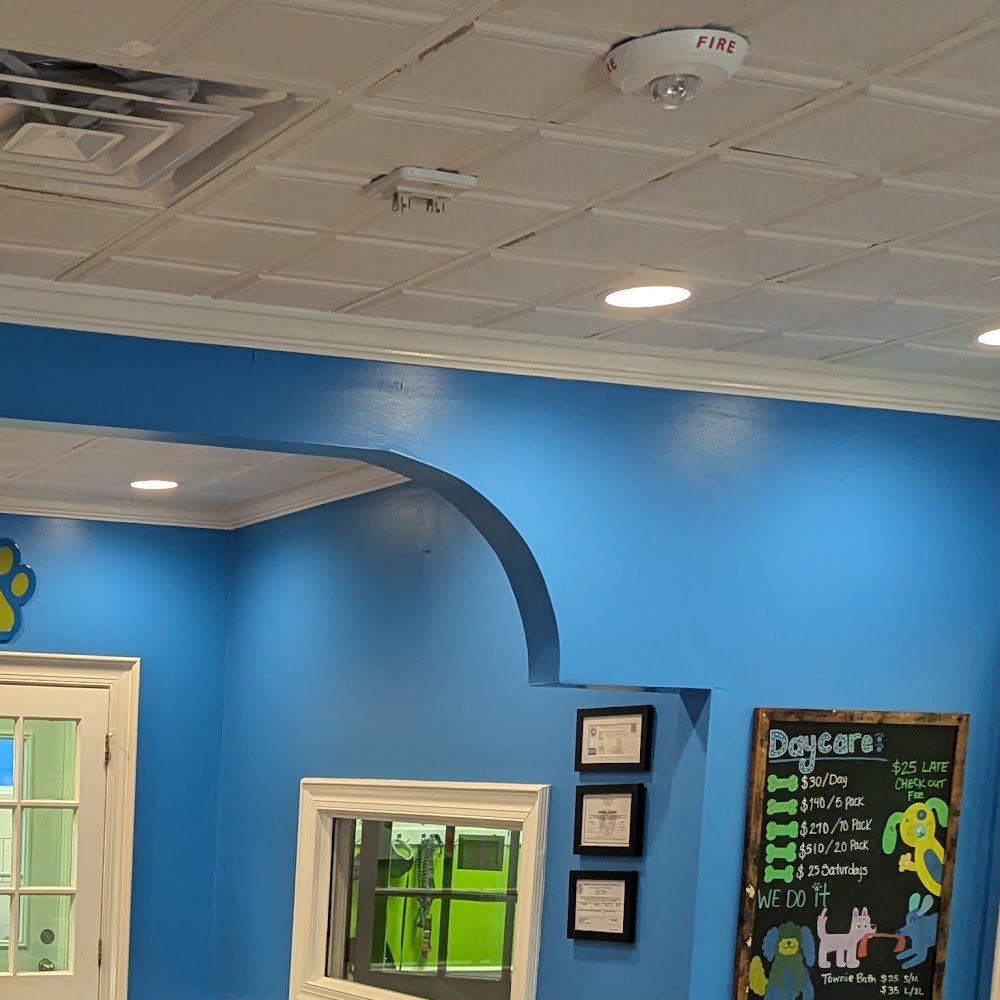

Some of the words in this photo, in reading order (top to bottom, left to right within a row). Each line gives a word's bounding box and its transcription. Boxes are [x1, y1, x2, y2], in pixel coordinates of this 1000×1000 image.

[696, 36, 737, 54] FIRE
[891, 759, 917, 776] $25
[922, 761, 950, 773] LATE
[801, 772, 848, 790] $30/Day
[895, 777, 926, 790] CHECK
[927, 778, 947, 789] OUT
[851, 818, 873, 831] Pack
[850, 839, 869, 851] Pack
[821, 862, 868, 883] Saturdays
[757, 889, 781, 909] WE
[786, 889, 806, 908] DO
[821, 972, 854, 985] Townie
[856, 972, 877, 984] Bath
[880, 974, 899, 984] $25
[903, 972, 919, 985] S/M
[880, 985, 900, 995] $35
[904, 986, 925, 996] L/XL
